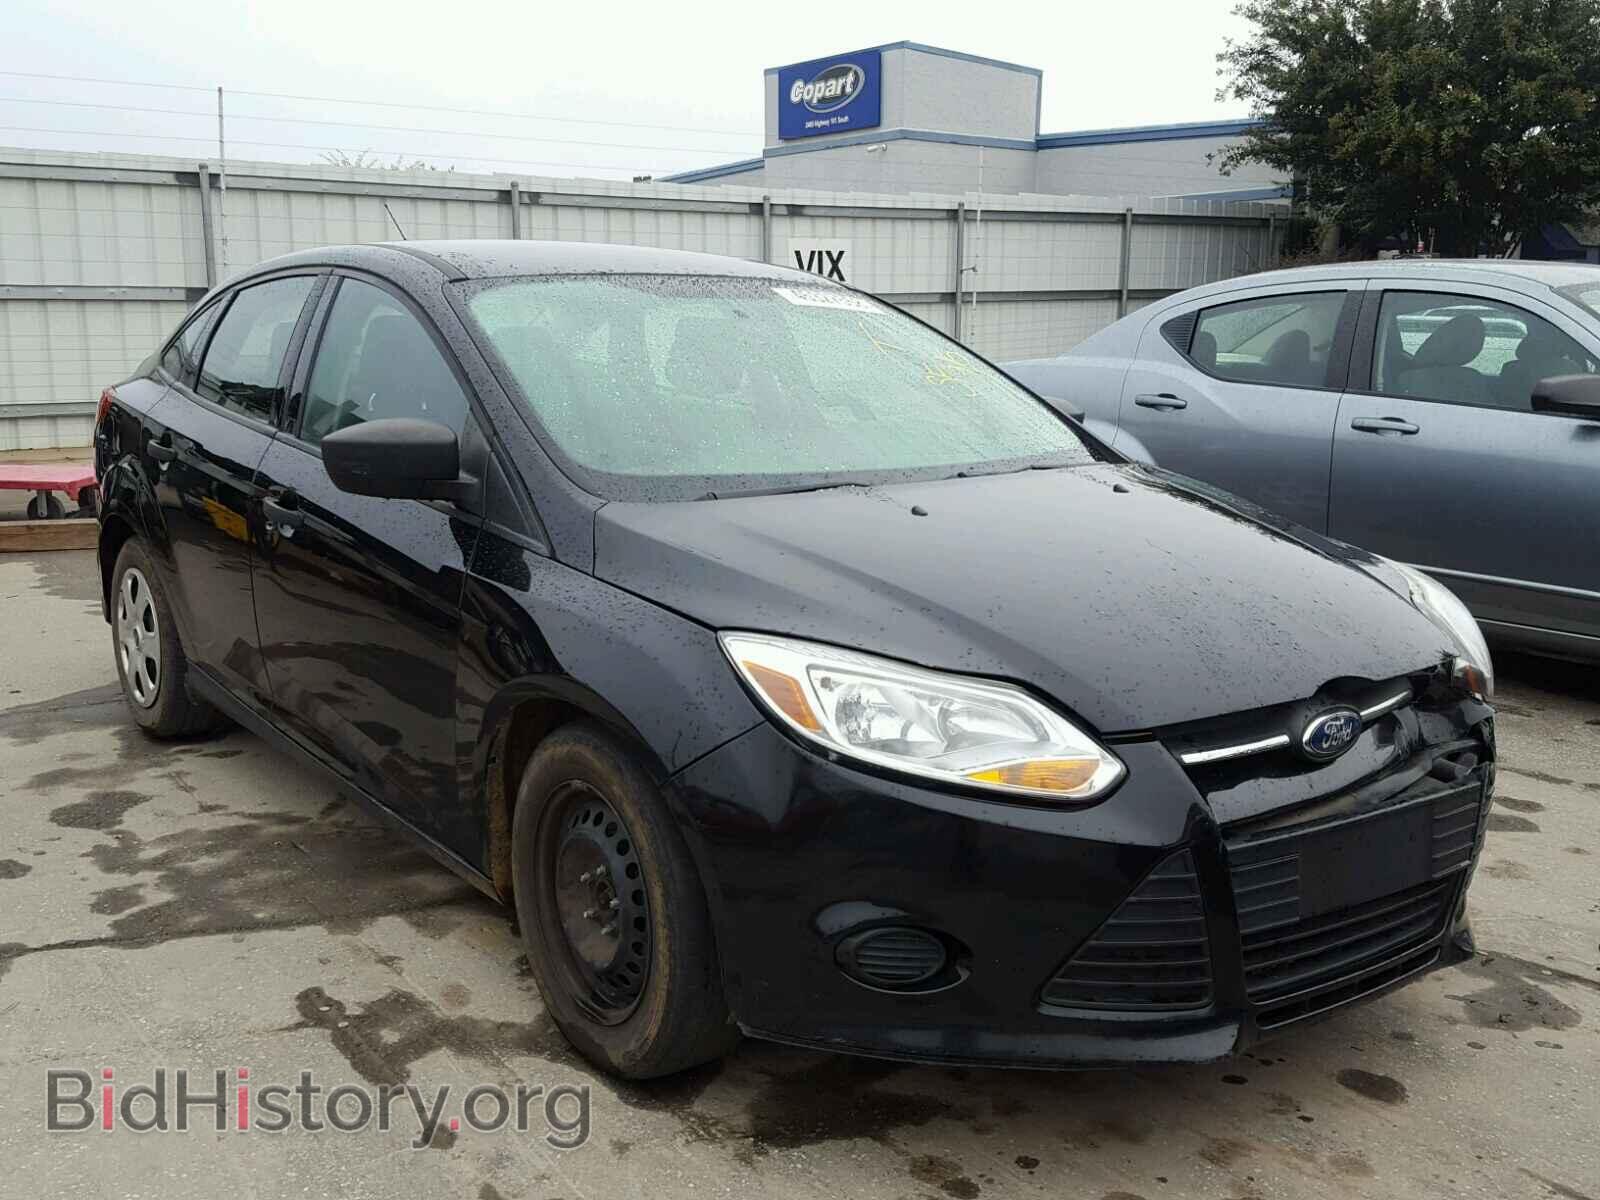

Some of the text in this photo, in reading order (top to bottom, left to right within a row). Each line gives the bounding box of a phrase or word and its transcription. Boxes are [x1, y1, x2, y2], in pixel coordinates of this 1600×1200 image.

[790, 69, 855, 105] Copart
[794, 250, 846, 281] VIX
[1322, 716, 1353, 748] Ford
